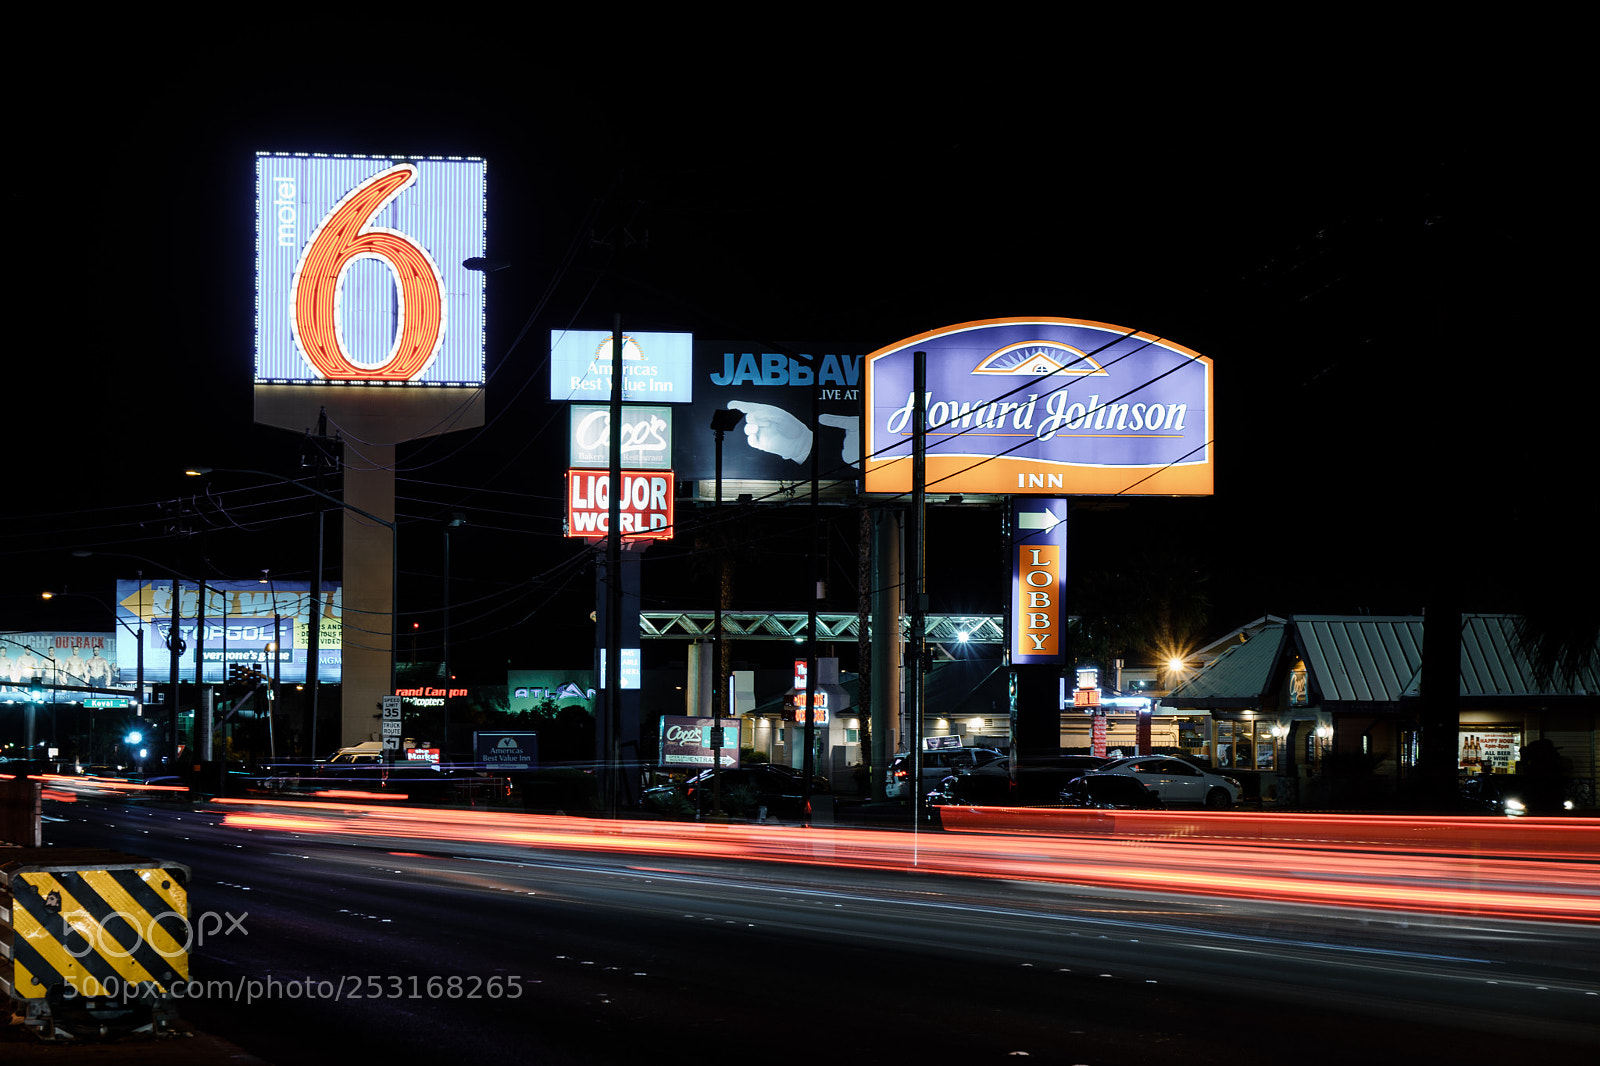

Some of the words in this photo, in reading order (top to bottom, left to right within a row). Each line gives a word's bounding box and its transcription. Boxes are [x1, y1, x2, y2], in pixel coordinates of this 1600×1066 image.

[273, 177, 296, 247] motel
[290, 163, 448, 381] 6
[588, 362, 659, 376] Amricas
[570, 376, 602, 390] Best
[606, 377, 647, 391] lue
[650, 378, 673, 392] Inn
[818, 389, 841, 400] IVE
[843, 389, 859, 400] AT
[887, 391, 1037, 433] Howard
[1036, 390, 1187, 441] Johnson
[578, 452, 605, 462] Bakery
[623, 452, 664, 462] Restaurant
[1018, 473, 1064, 488] INN
[572, 475, 668, 511] LIQUOR
[572, 512, 668, 533] WORLD
[1026, 549, 1053, 650] LOBBY
[179, 625, 288, 641] TOPGOLF
[55, 636, 104, 649] OUTBACK
[203, 650, 257, 662] veryone's
[395, 687, 424, 696] rand
[384, 708, 399, 717] 35
[408, 752, 440, 763] Market
[689, 755, 726, 763] ENTRAE
